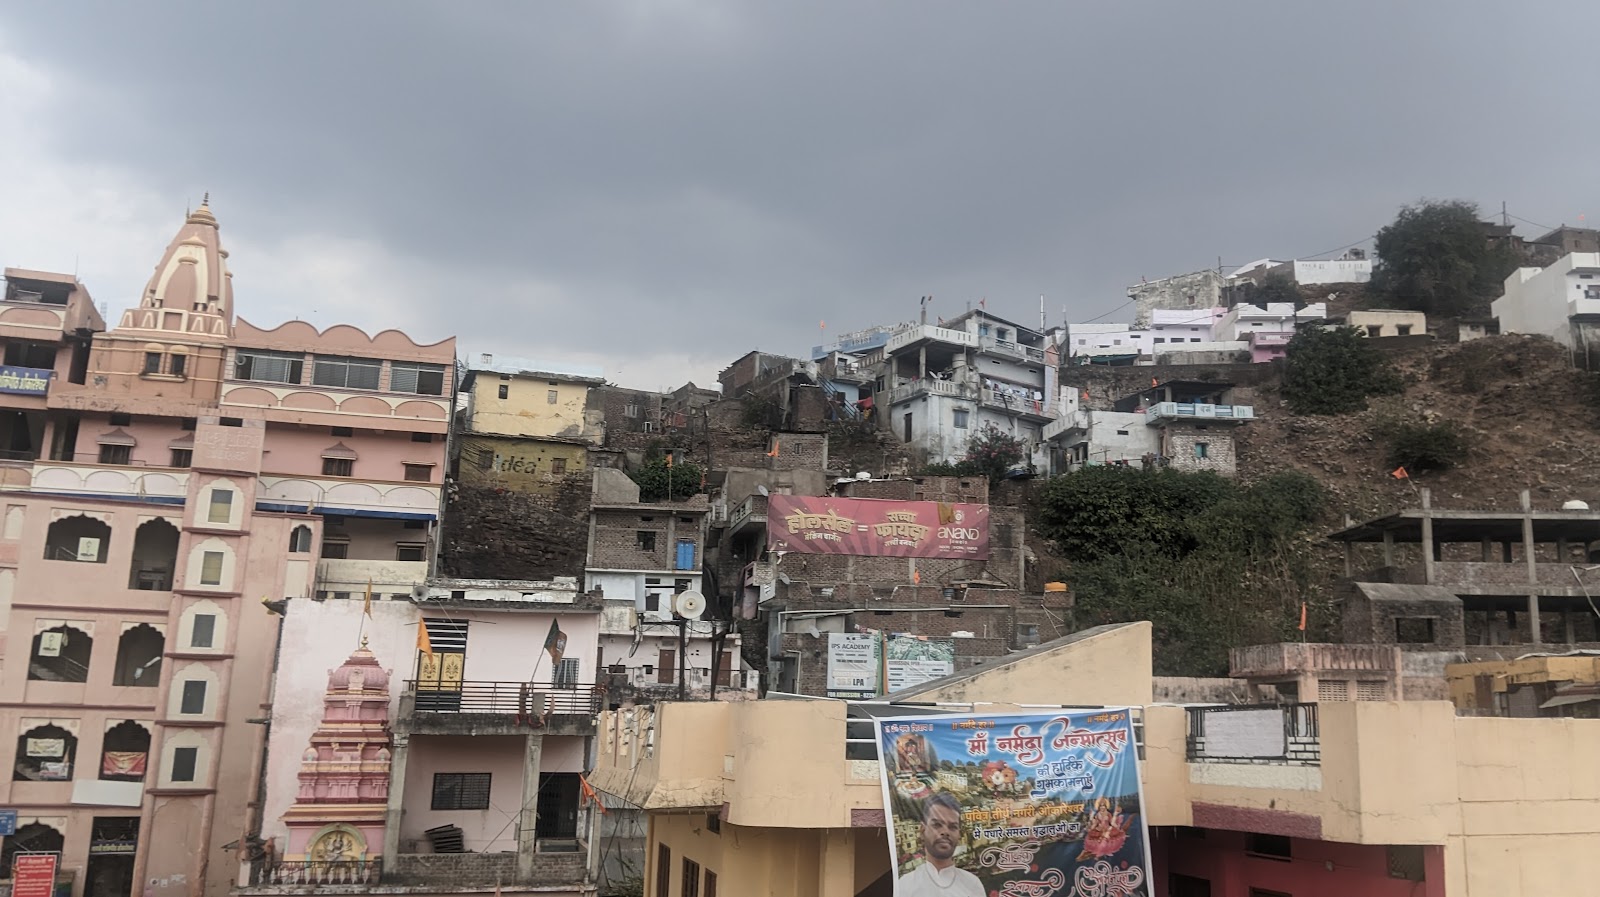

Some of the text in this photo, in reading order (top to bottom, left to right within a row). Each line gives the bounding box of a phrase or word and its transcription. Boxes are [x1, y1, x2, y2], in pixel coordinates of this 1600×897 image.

[784, 508, 855, 534] होलसेल
[874, 522, 929, 541] फायदा
[852, 678, 865, 687] LPA
[996, 725, 1044, 766] नर्मदा
[1051, 756, 1083, 776] हार्दिक
[965, 809, 989, 821] पवित्र
[992, 805, 1010, 819] तीर्थ
[1013, 805, 1035, 818] नगरी
[1005, 826, 1029, 838] समस्त
[1069, 822, 1080, 833] का
